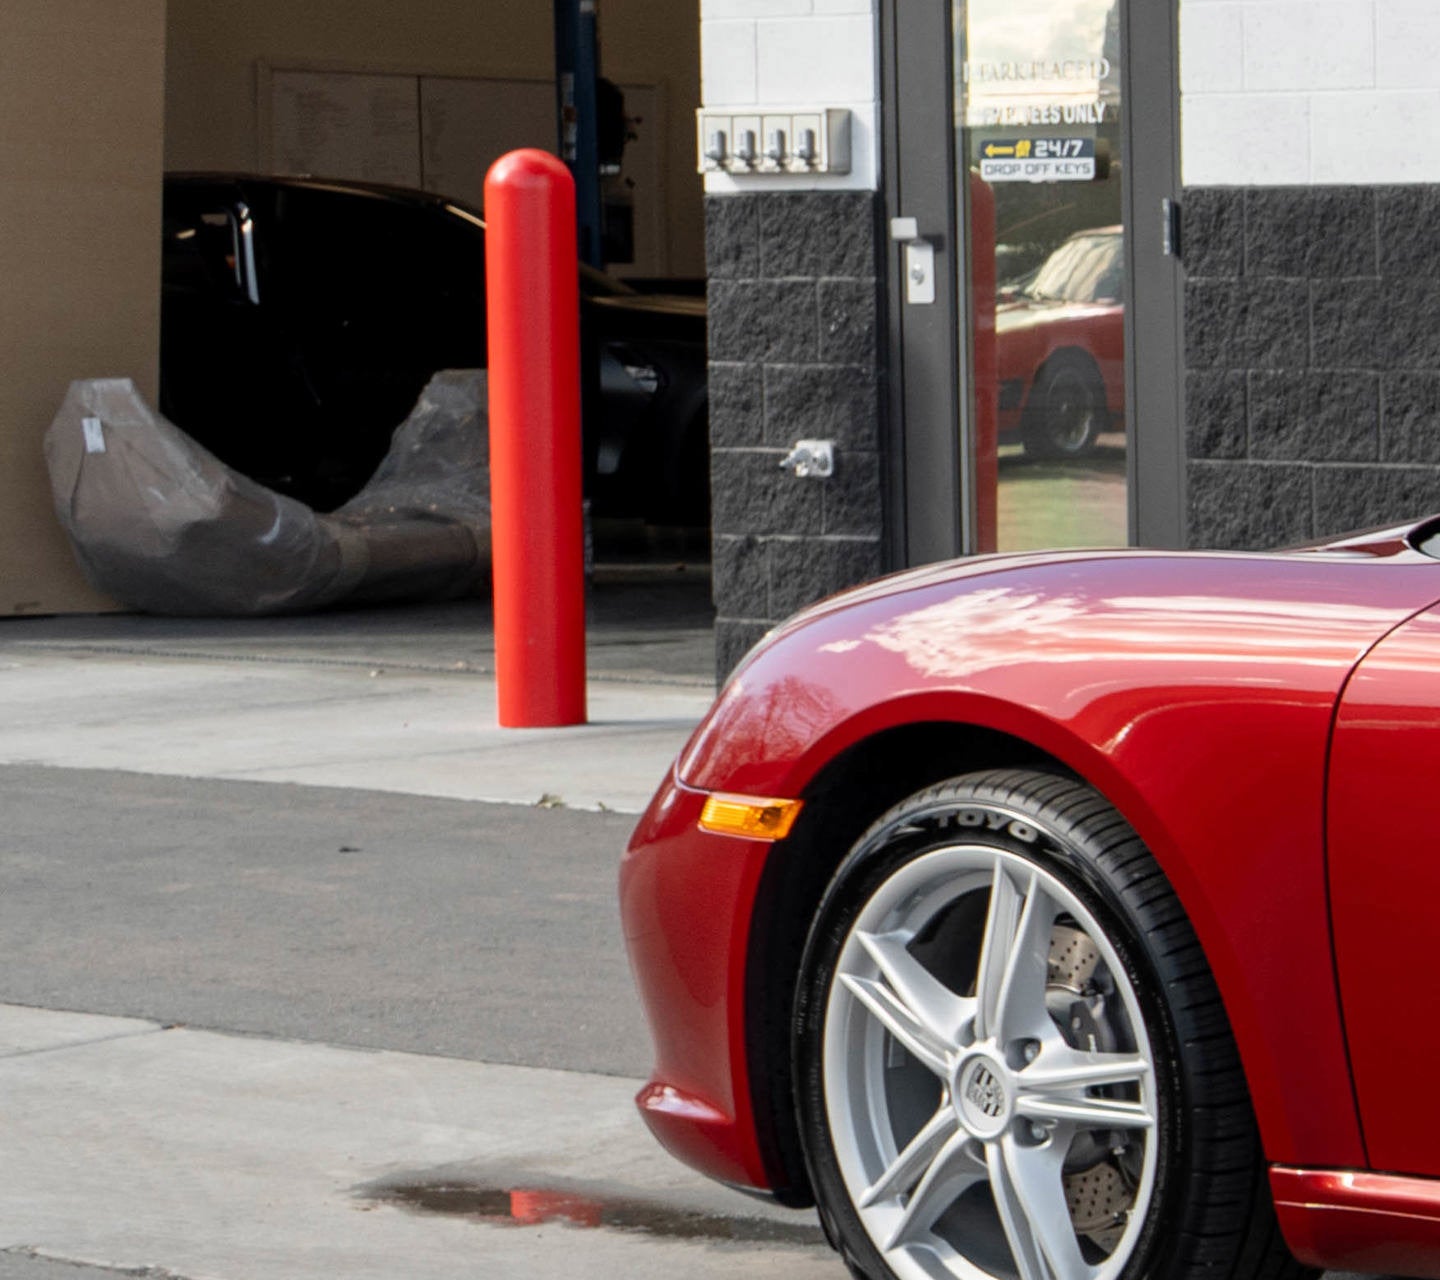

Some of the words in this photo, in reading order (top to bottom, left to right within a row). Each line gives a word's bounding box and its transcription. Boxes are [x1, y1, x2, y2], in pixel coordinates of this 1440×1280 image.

[1063, 100, 1106, 124] ONLY
[1034, 139, 1084, 158] 24/7
[984, 163, 1021, 176] DROP
[1025, 163, 1050, 176] OFF
[1055, 162, 1092, 176] KEYS
[934, 810, 1039, 844] TOYO
